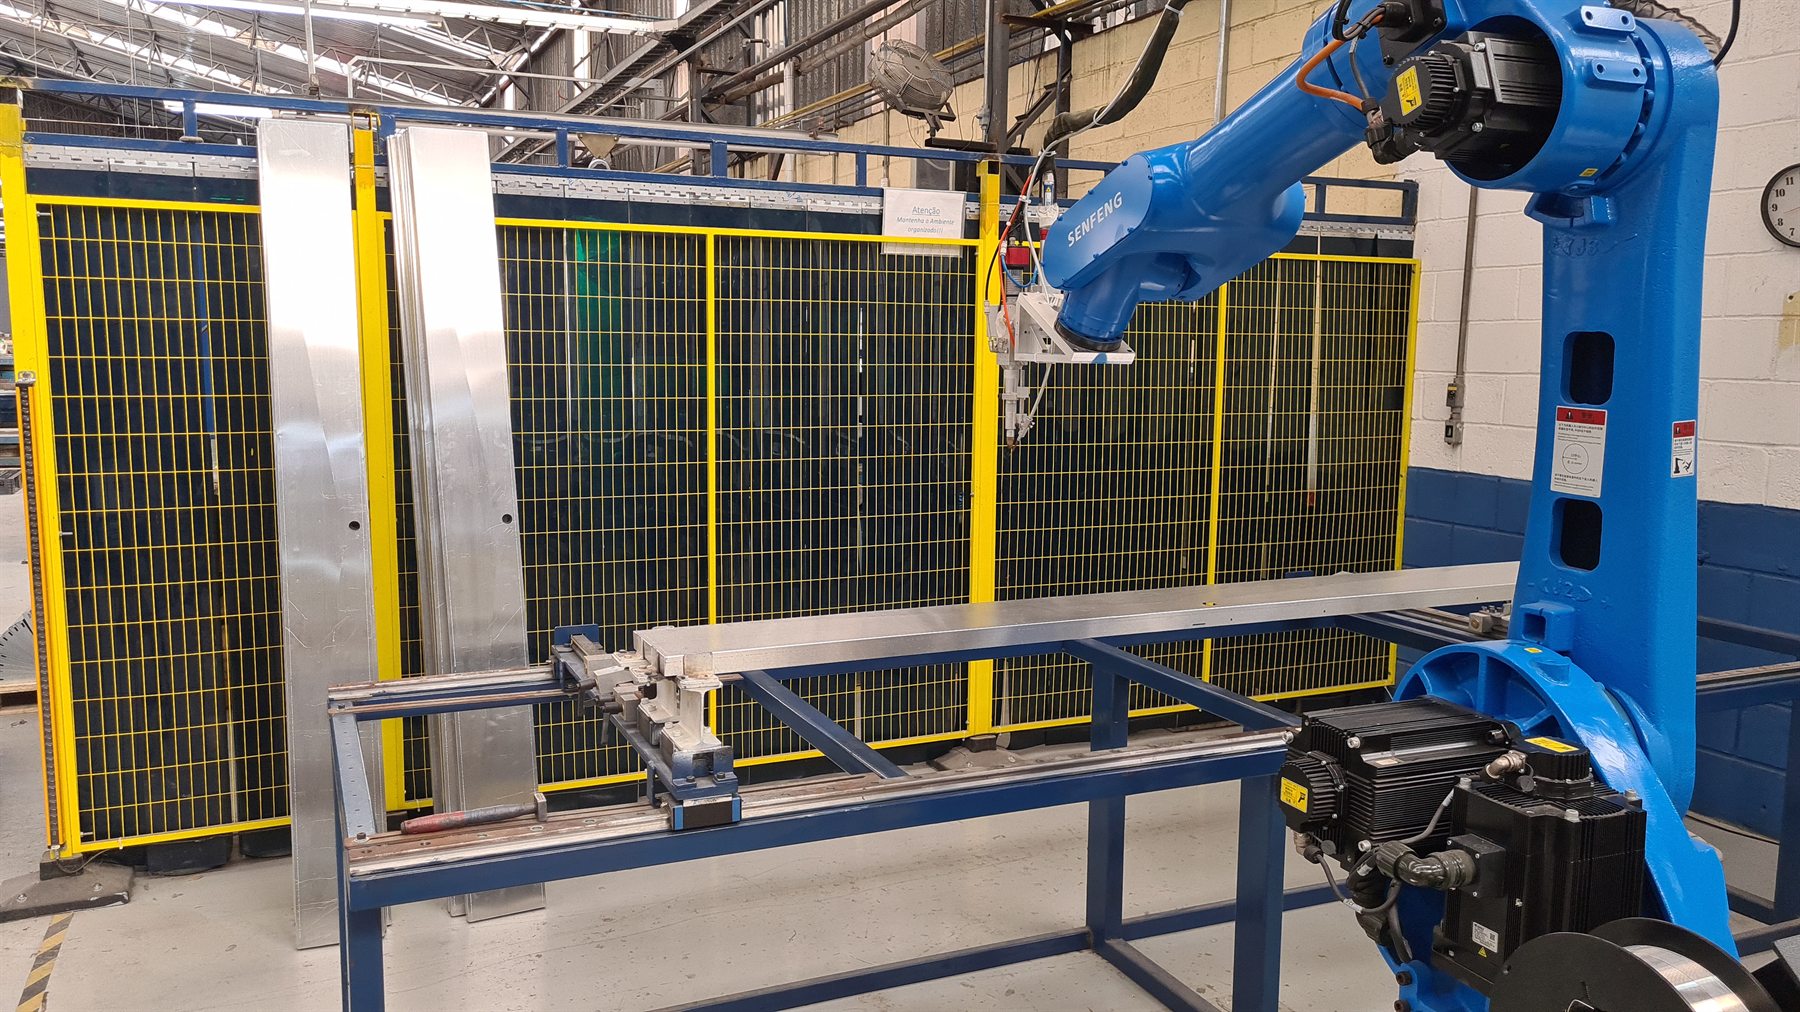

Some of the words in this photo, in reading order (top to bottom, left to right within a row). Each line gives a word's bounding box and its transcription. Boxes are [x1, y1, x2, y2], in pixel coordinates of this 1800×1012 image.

[1785, 177, 1794, 185] 11
[1775, 189, 1785, 197] 10
[912, 206, 941, 216] Atenção
[1771, 203, 1778, 211] 9
[1067, 191, 1123, 247] SENFENG
[1777, 218, 1783, 226] 8
[1789, 228, 1795, 236] 7
